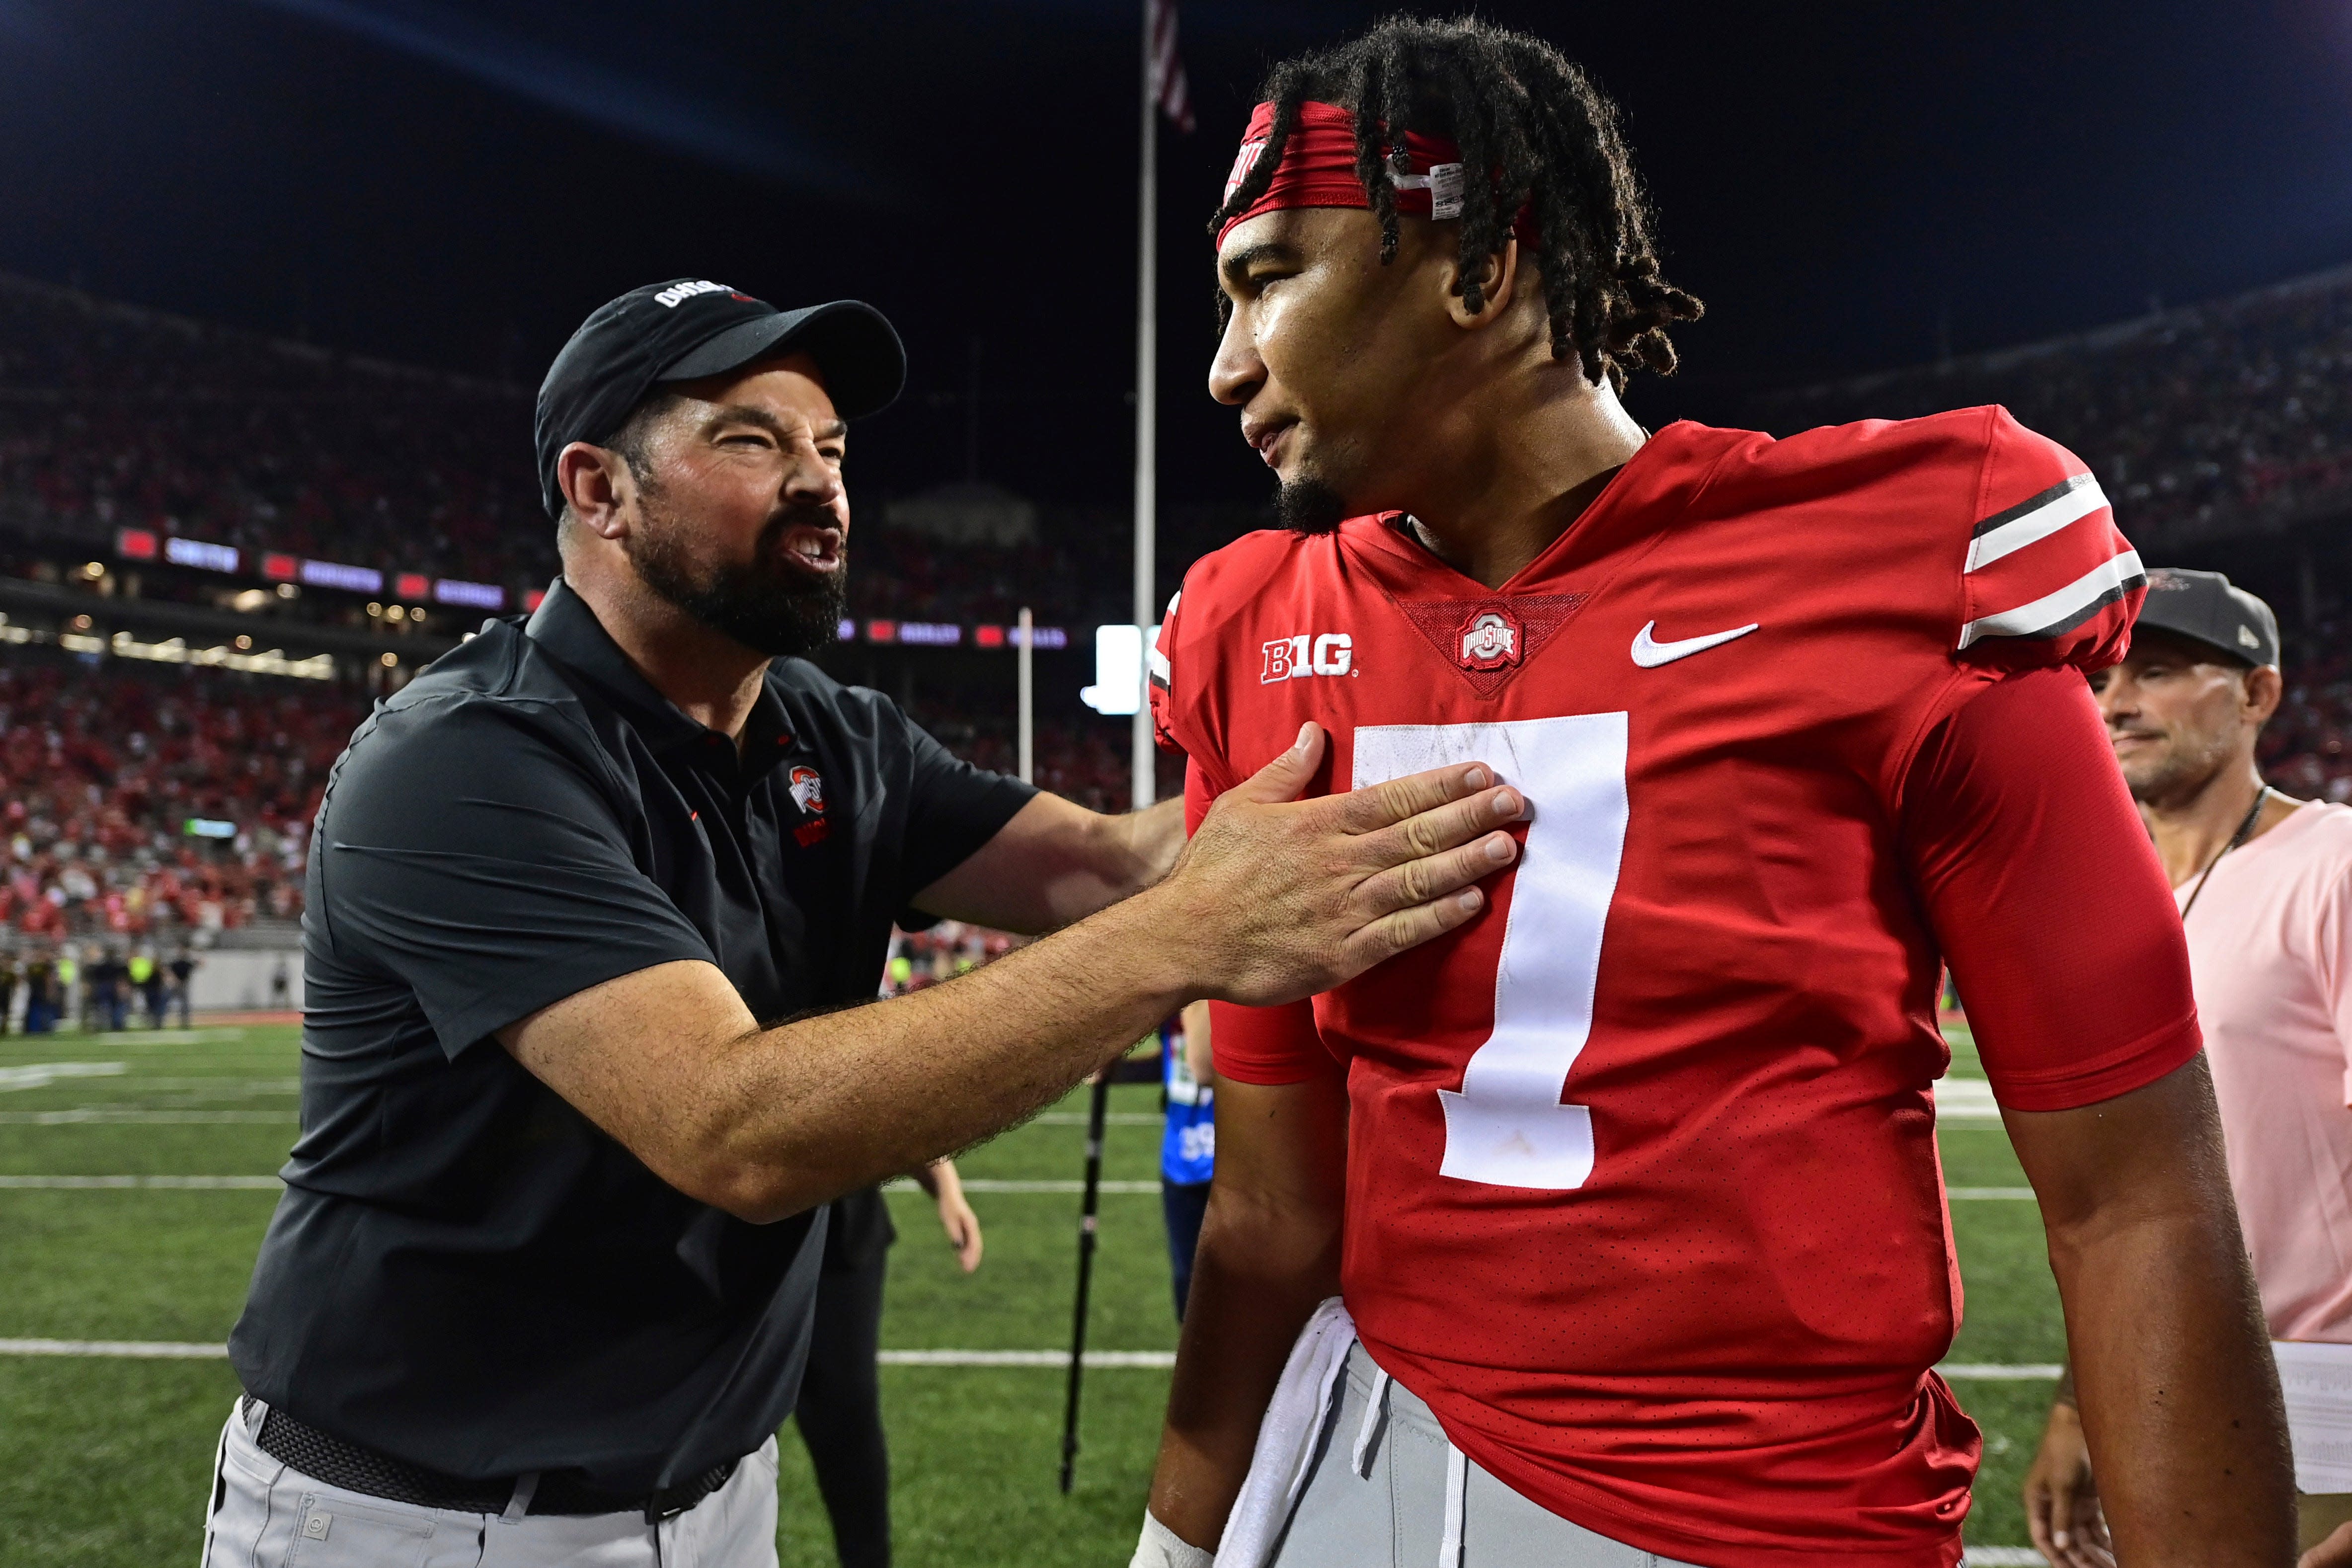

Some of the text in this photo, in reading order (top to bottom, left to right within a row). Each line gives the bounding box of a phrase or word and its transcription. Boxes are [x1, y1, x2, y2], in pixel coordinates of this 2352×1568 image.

[1463, 625, 1514, 659] OHIO STATE
[1351, 710, 1630, 1190] 7
